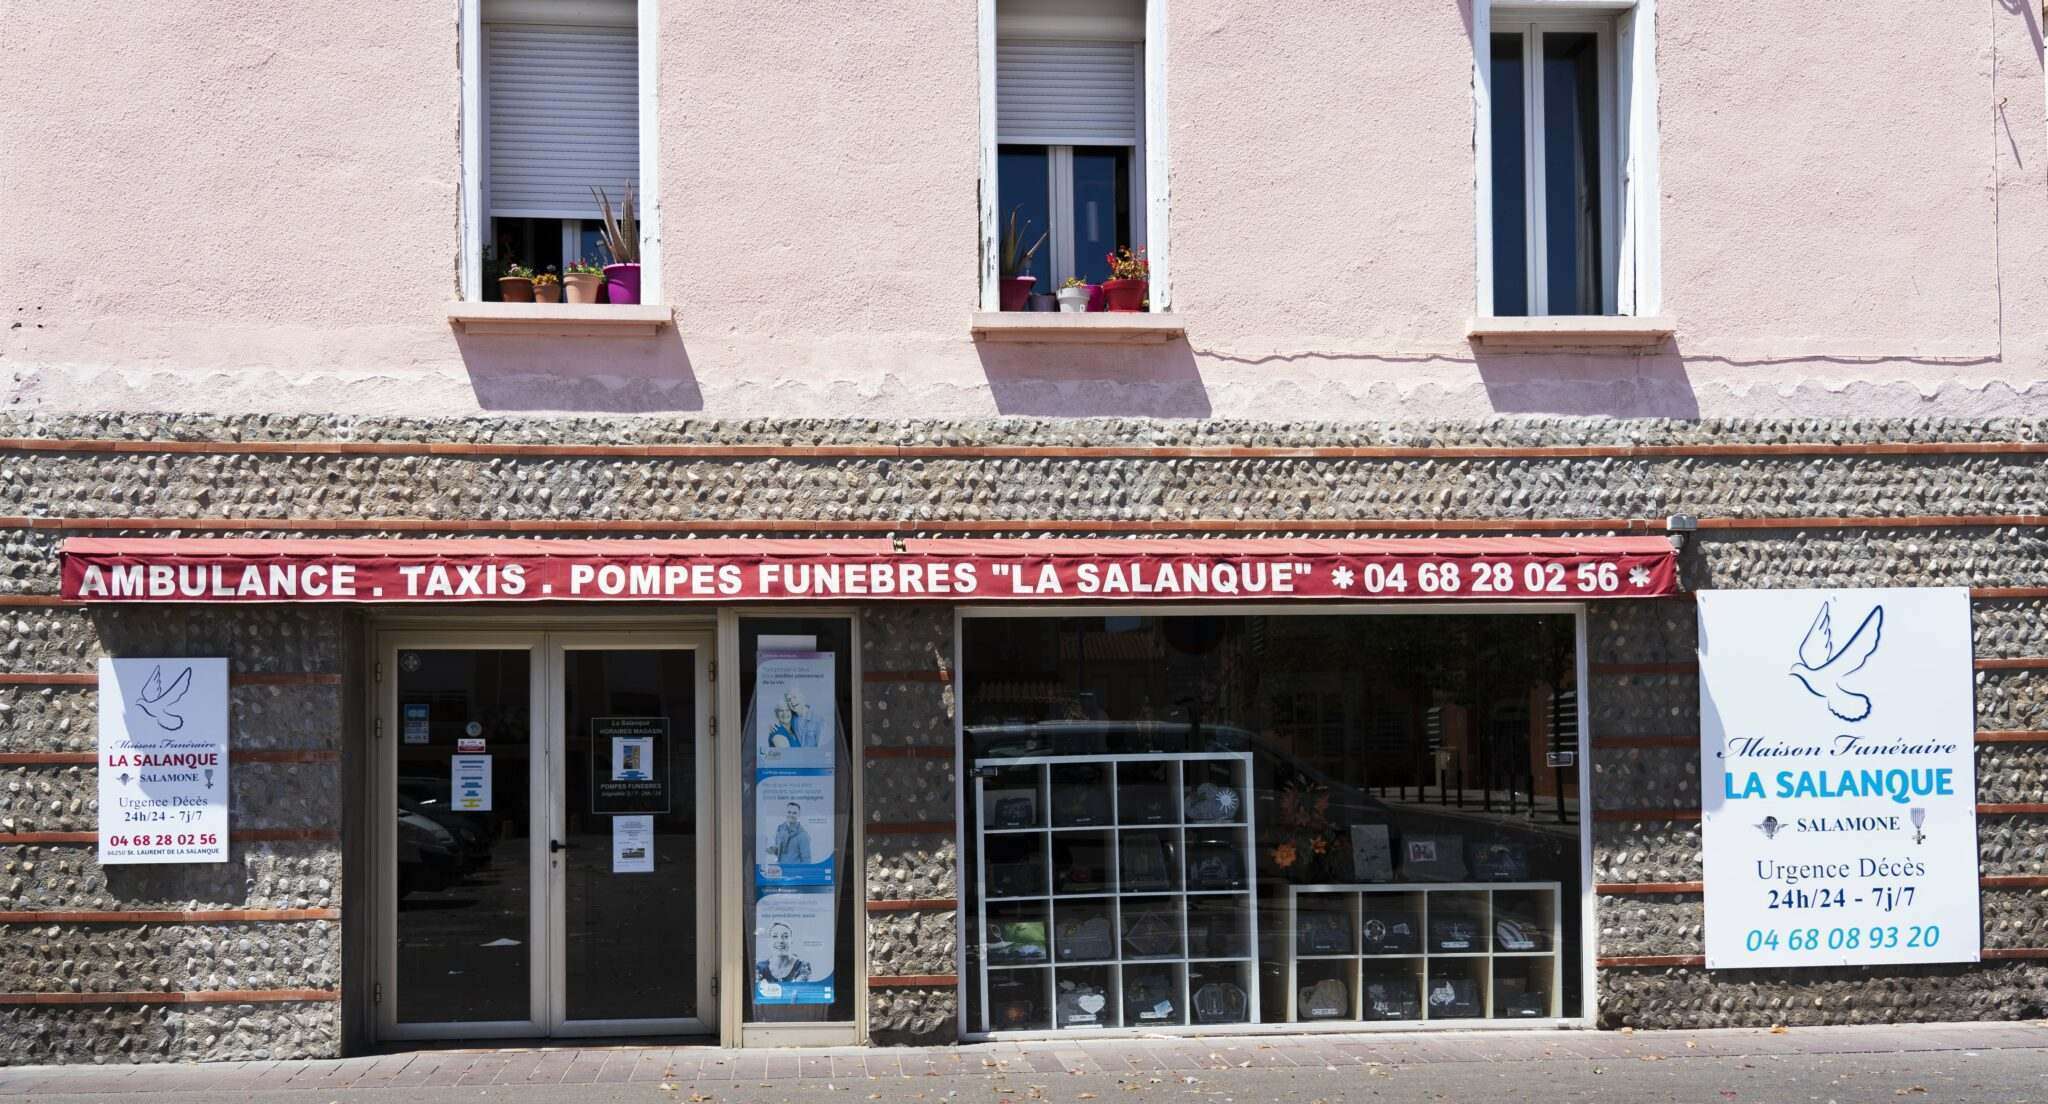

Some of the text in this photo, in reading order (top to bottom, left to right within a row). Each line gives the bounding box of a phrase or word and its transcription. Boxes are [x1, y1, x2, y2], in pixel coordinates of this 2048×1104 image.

[78, 564, 356, 597] AMBULANCE
[399, 563, 526, 596] TAXIS
[571, 564, 742, 595] POMPES
[759, 562, 977, 594] FUNEBRES
[992, 563, 1064, 594] "LA
[1077, 562, 1312, 595] SALANQUE"
[1364, 562, 1408, 593] 04
[1417, 562, 1461, 592] 68
[1471, 562, 1514, 592] 28
[1523, 562, 1566, 592] 02
[1577, 562, 1619, 592] 56
[110, 739, 216, 749] Maison Funéraire
[1717, 734, 1958, 760] Maison Funéraire
[109, 753, 218, 769] LA SALANQUE
[140, 773, 200, 783] SALAMONE
[1724, 768, 1955, 804] LA SALANQUE
[119, 796, 208, 810] Urgence Décès
[125, 811, 165, 821] 24h/24
[179, 810, 202, 823] 7j/7
[1797, 816, 1900, 832] SALAMONE
[110, 834, 217, 847] 04 68 28 02 56
[1757, 857, 1925, 884] Urgence Décès
[1767, 888, 1846, 909] 24h/24
[1872, 886, 1916, 912] 7j/7
[1746, 925, 1940, 951] 04 68 08 93 20
